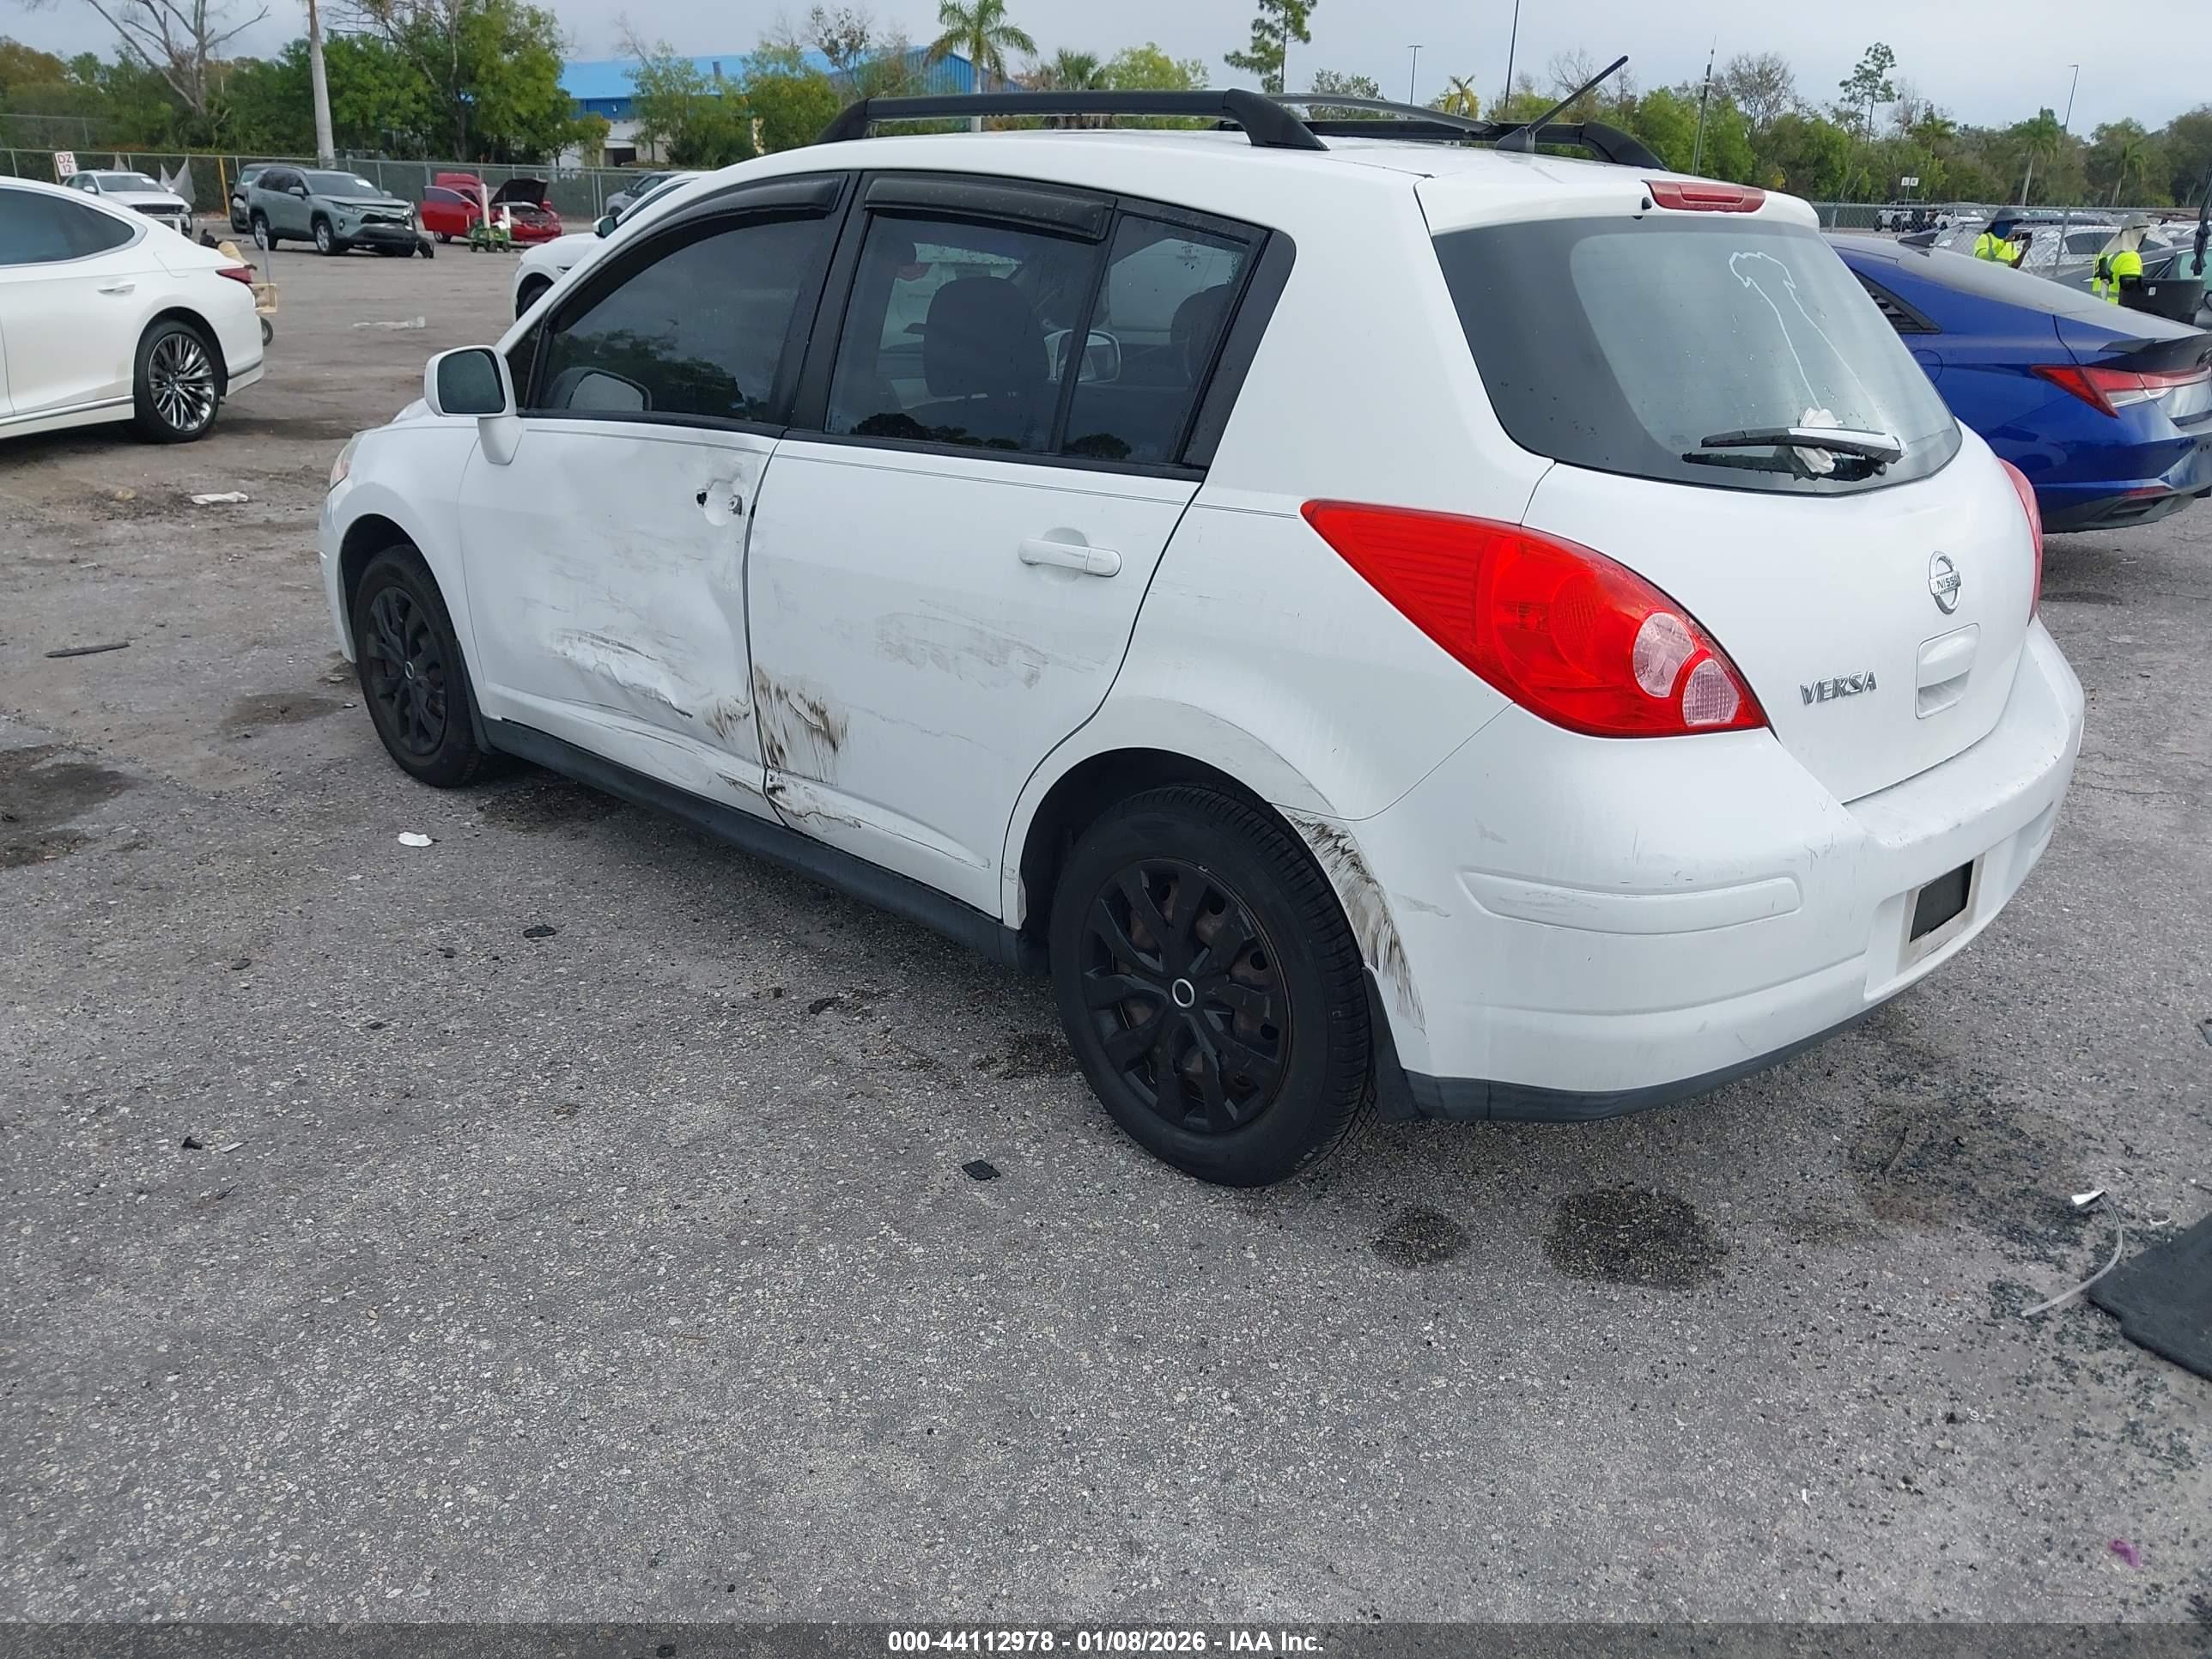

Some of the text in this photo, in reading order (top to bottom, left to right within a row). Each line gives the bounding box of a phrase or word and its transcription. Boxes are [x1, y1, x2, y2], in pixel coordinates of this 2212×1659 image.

[58, 154, 73, 163] DZ
[62, 164, 73, 173] 12
[1800, 671, 1877, 705] VERSA
